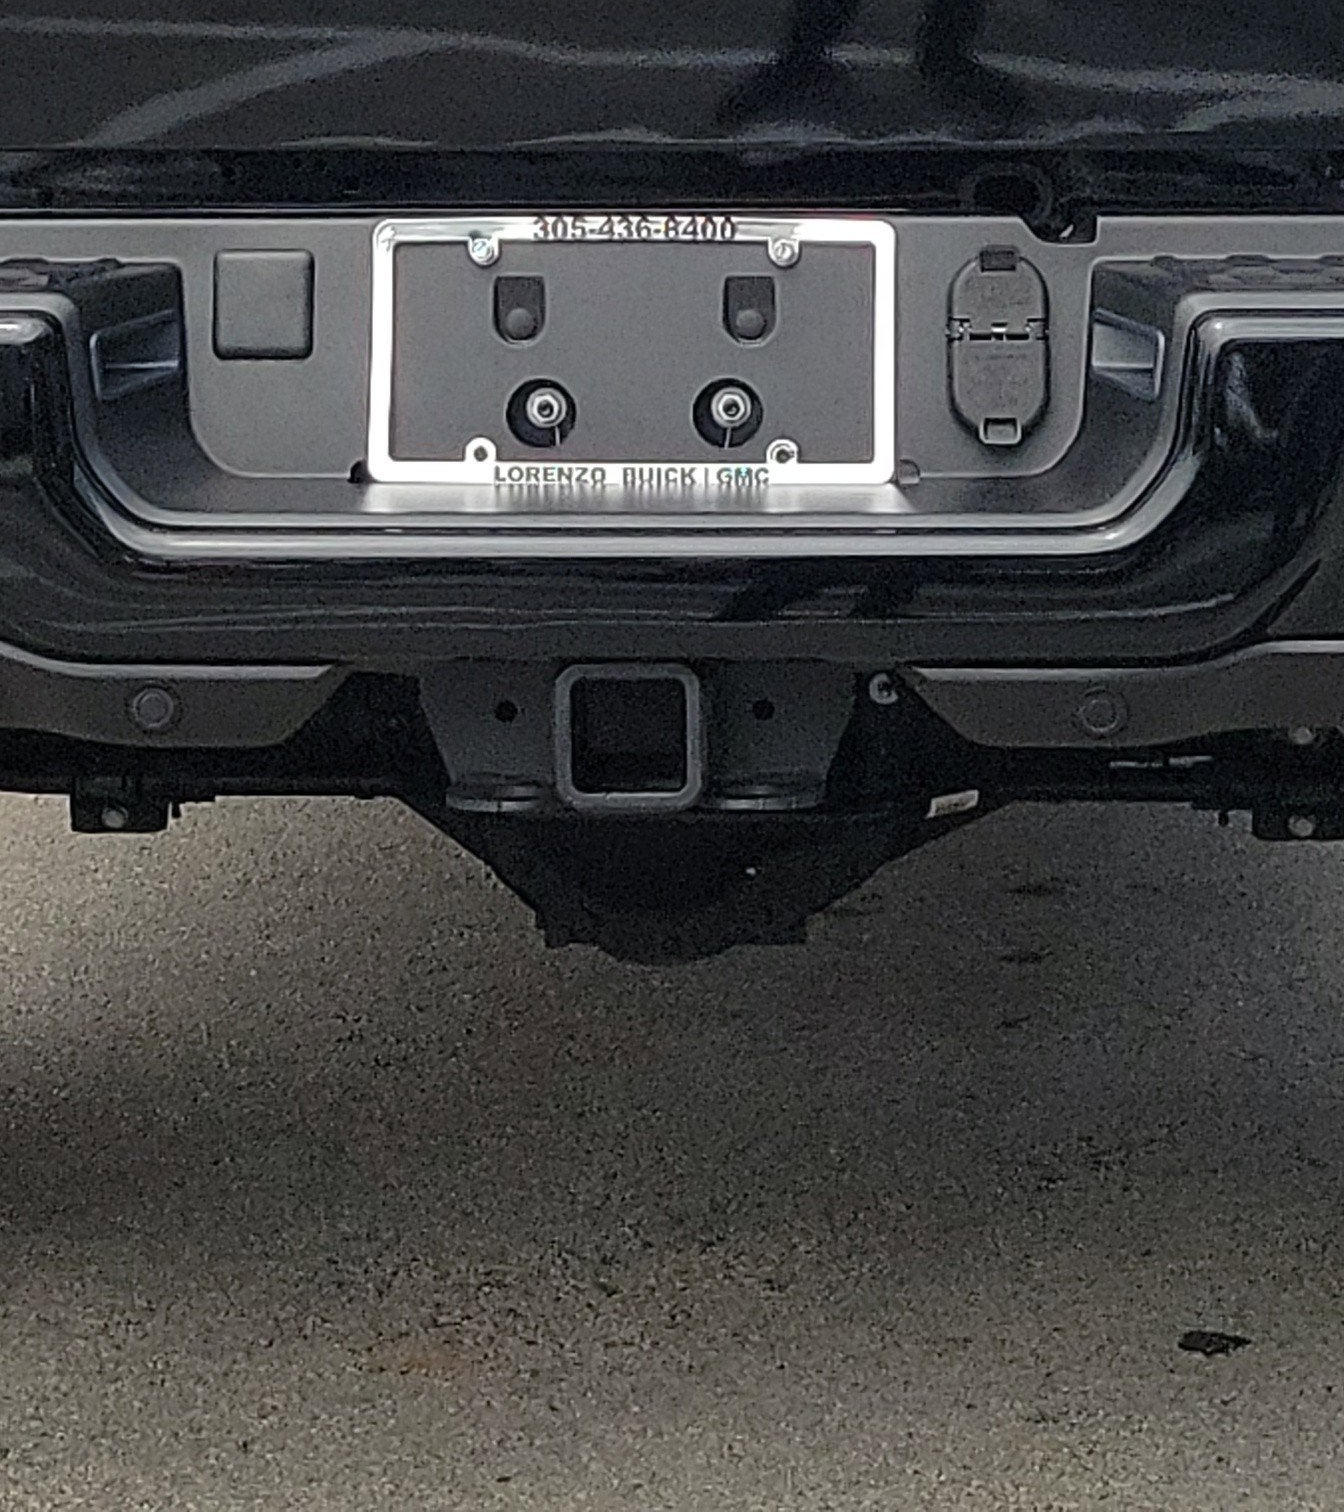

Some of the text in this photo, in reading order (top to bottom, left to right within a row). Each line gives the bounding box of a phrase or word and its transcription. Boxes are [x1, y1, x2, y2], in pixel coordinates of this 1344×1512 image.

[533, 214, 738, 241] 305-436-8400
[494, 465, 770, 488] LORENZO BUICK GMC
